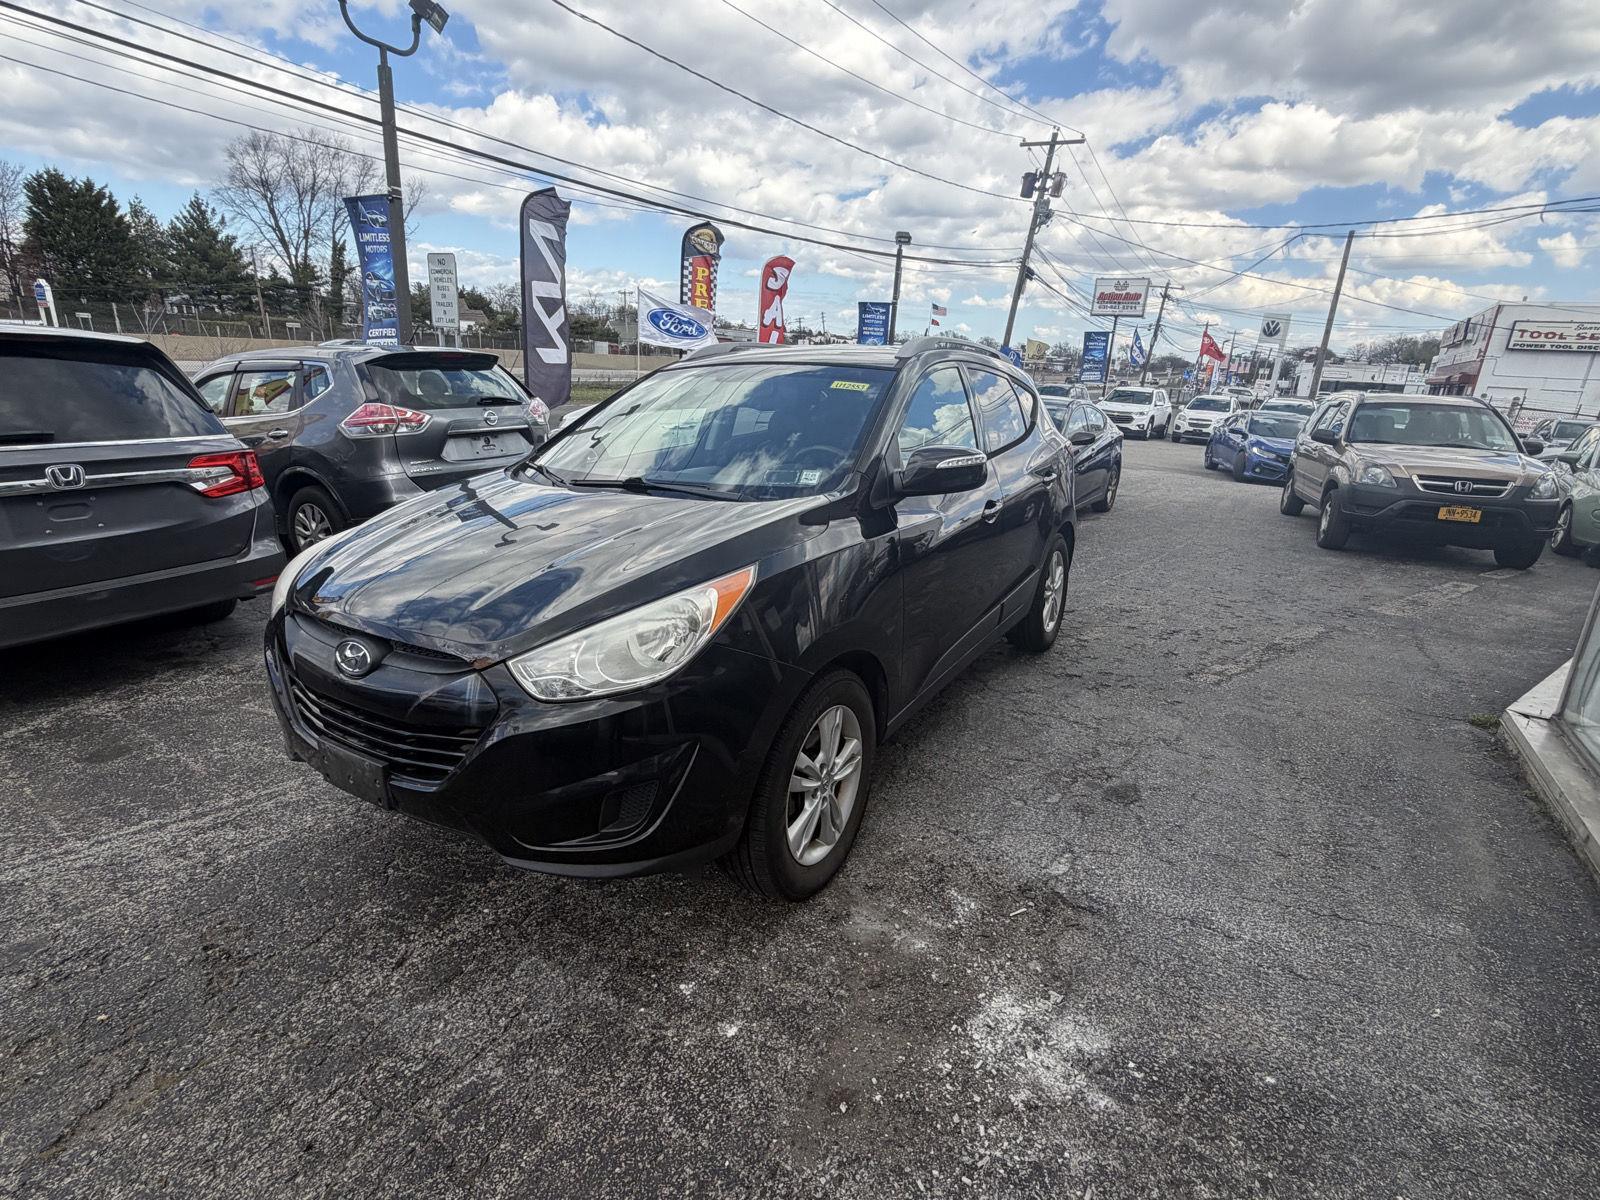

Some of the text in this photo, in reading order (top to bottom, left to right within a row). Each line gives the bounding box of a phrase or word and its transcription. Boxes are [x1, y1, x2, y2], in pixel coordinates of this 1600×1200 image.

[359, 233, 390, 243] LIMITLESS
[365, 245, 388, 254] MOTORS
[437, 258, 446, 266] NO
[1096, 291, 1143, 301] Action Auto
[659, 312, 699, 337] Ford
[368, 328, 397, 337] CERTIFIED
[1518, 329, 1600, 341] TOOL SE
